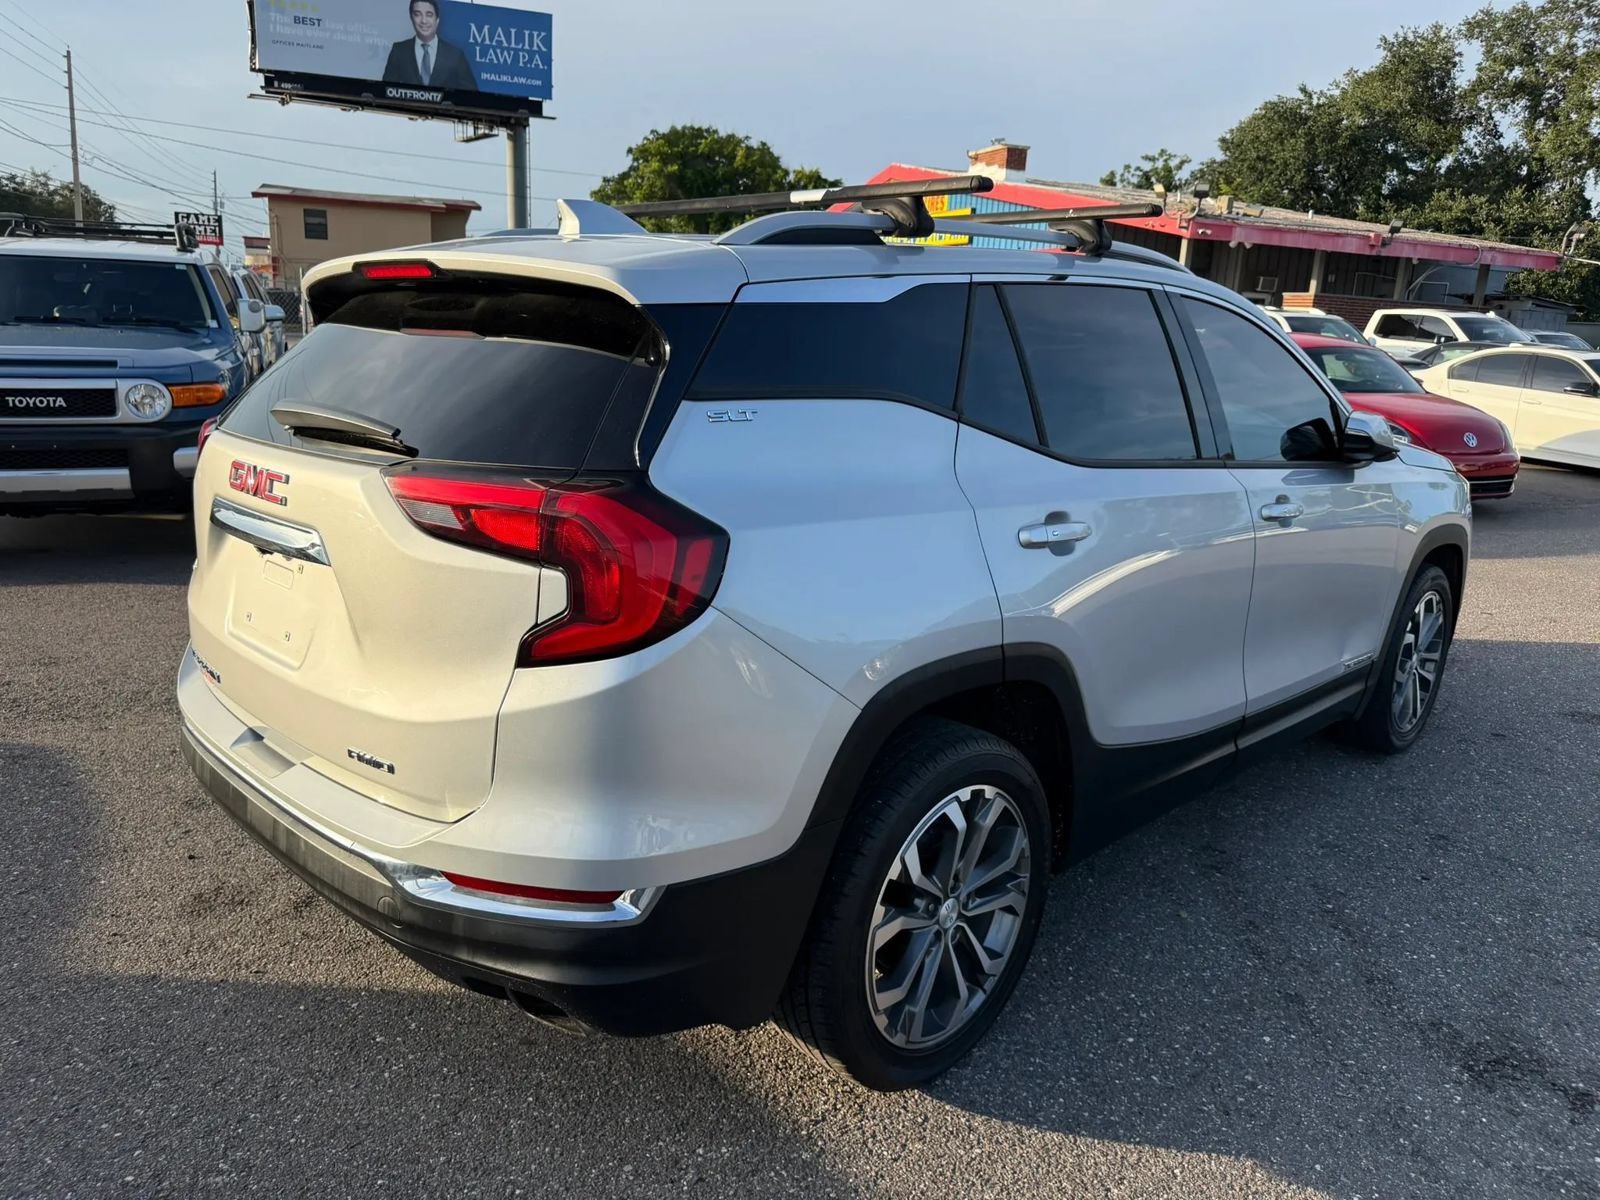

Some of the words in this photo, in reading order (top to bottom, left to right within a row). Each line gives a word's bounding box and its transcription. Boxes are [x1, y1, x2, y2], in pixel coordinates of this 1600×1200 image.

[293, 15, 322, 27] BEST
[468, 22, 548, 52] MALIK
[475, 46, 515, 65] LAW
[518, 51, 548, 70] P.A.
[178, 213, 219, 226] GAME
[5, 396, 68, 408] TOYOTA
[706, 409, 758, 423] SLT
[229, 459, 290, 507] GMC
